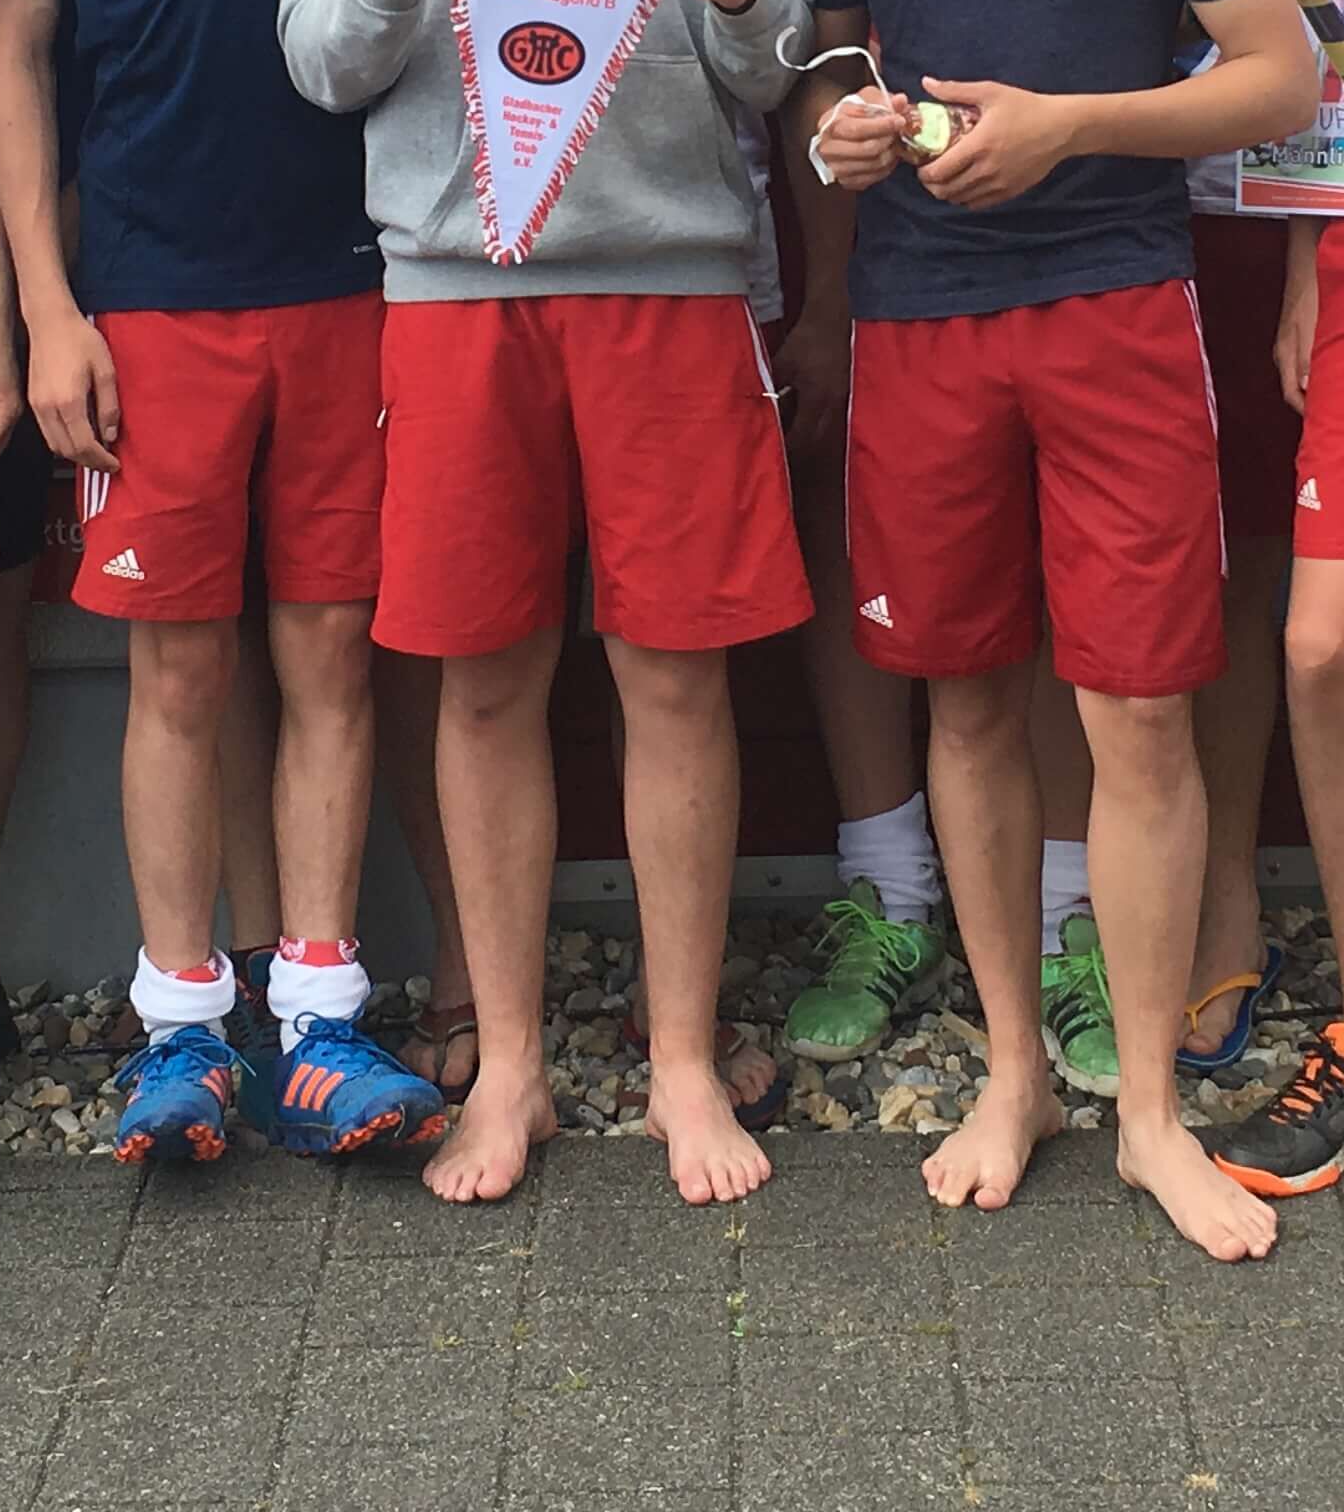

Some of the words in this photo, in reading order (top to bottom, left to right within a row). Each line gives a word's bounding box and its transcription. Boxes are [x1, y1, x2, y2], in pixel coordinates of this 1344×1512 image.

[514, 141, 538, 154] Club
[102, 564, 145, 581] adidas
[860, 607, 893, 628] adidas
